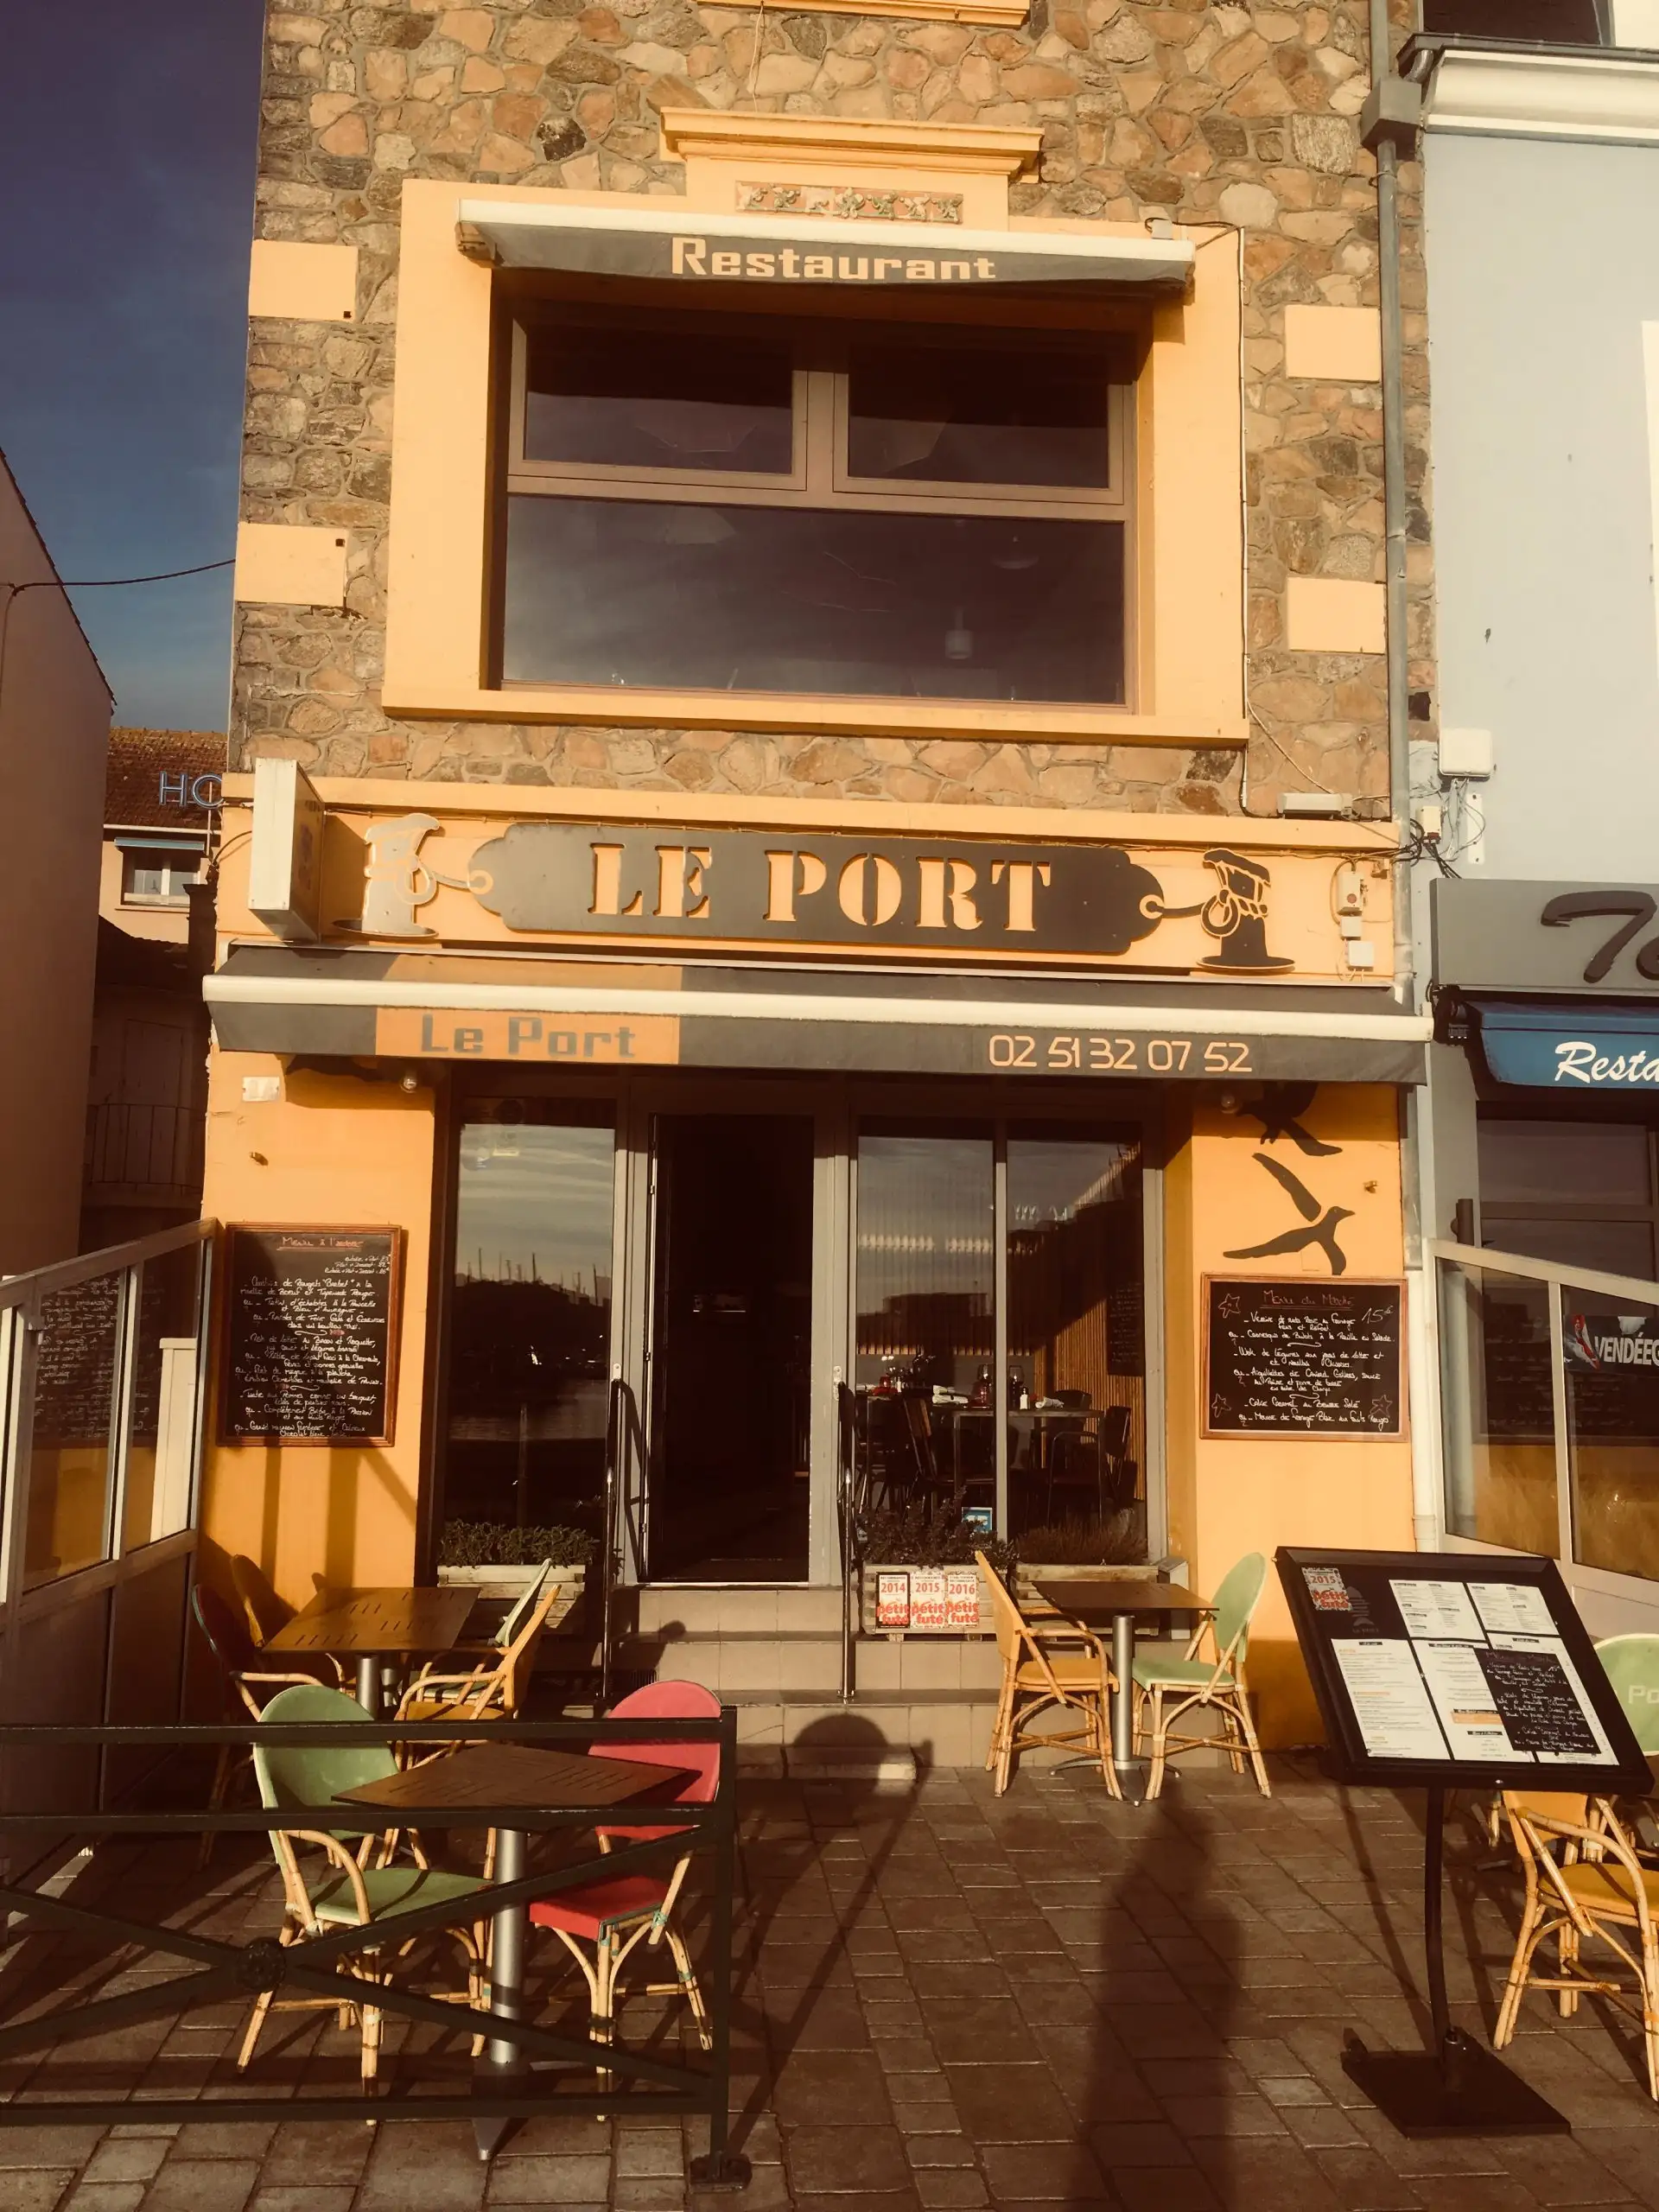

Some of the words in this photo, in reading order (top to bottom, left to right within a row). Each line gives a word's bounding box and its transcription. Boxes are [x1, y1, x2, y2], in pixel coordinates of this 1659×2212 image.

[671, 237, 996, 280] Restaurant
[588, 842, 713, 918] LE
[763, 849, 1052, 932] PORT
[421, 1014, 485, 1054] Le
[508, 1016, 636, 1058] Port
[989, 1034, 1038, 1067] 02
[1048, 1037, 1080, 1069] 51
[1090, 1038, 1137, 1071] 32
[1147, 1039, 1192, 1071] 07
[1204, 1042, 1253, 1072] 52
[880, 1582, 906, 1593] 2014
[916, 1582, 940, 1593] 2015
[949, 1583, 976, 1595] 2016
[1310, 1574, 1338, 1585] 2015
